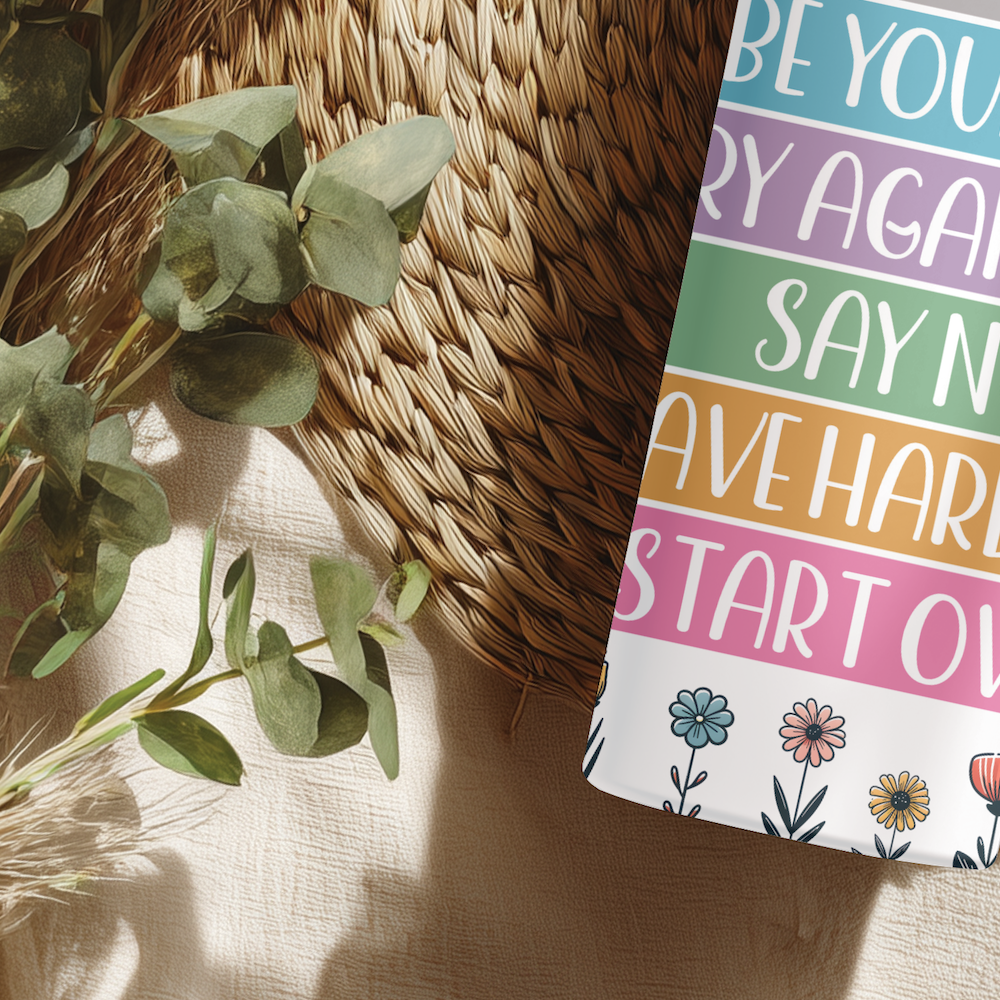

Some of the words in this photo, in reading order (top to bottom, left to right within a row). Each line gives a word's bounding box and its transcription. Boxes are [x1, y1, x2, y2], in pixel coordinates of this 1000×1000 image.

[754, 278, 929, 395] SAY
[641, 391, 803, 511] AVE
[613, 527, 892, 669] START
